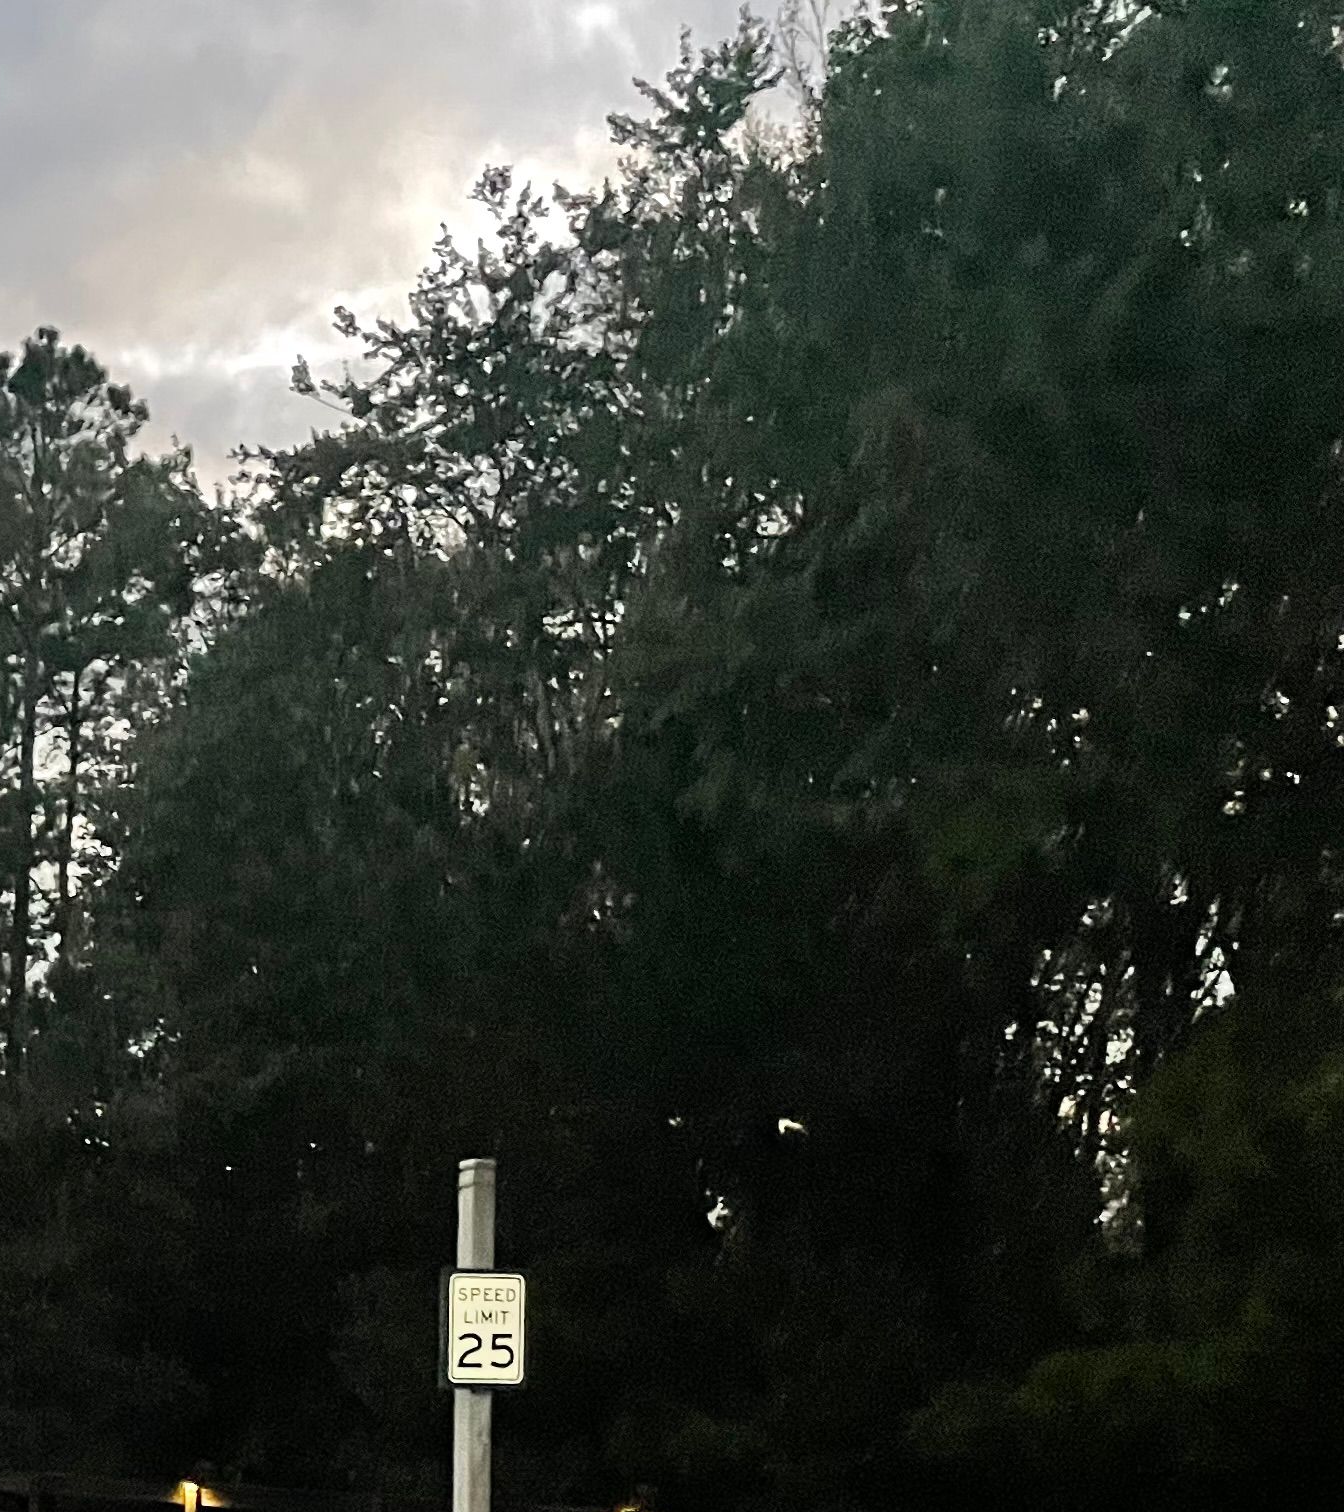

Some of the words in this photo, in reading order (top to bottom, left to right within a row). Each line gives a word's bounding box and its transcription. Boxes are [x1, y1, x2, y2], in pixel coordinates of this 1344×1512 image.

[458, 1287, 516, 1302] SPEED
[464, 1310, 510, 1325] LIMIT
[457, 1333, 514, 1368] 25
